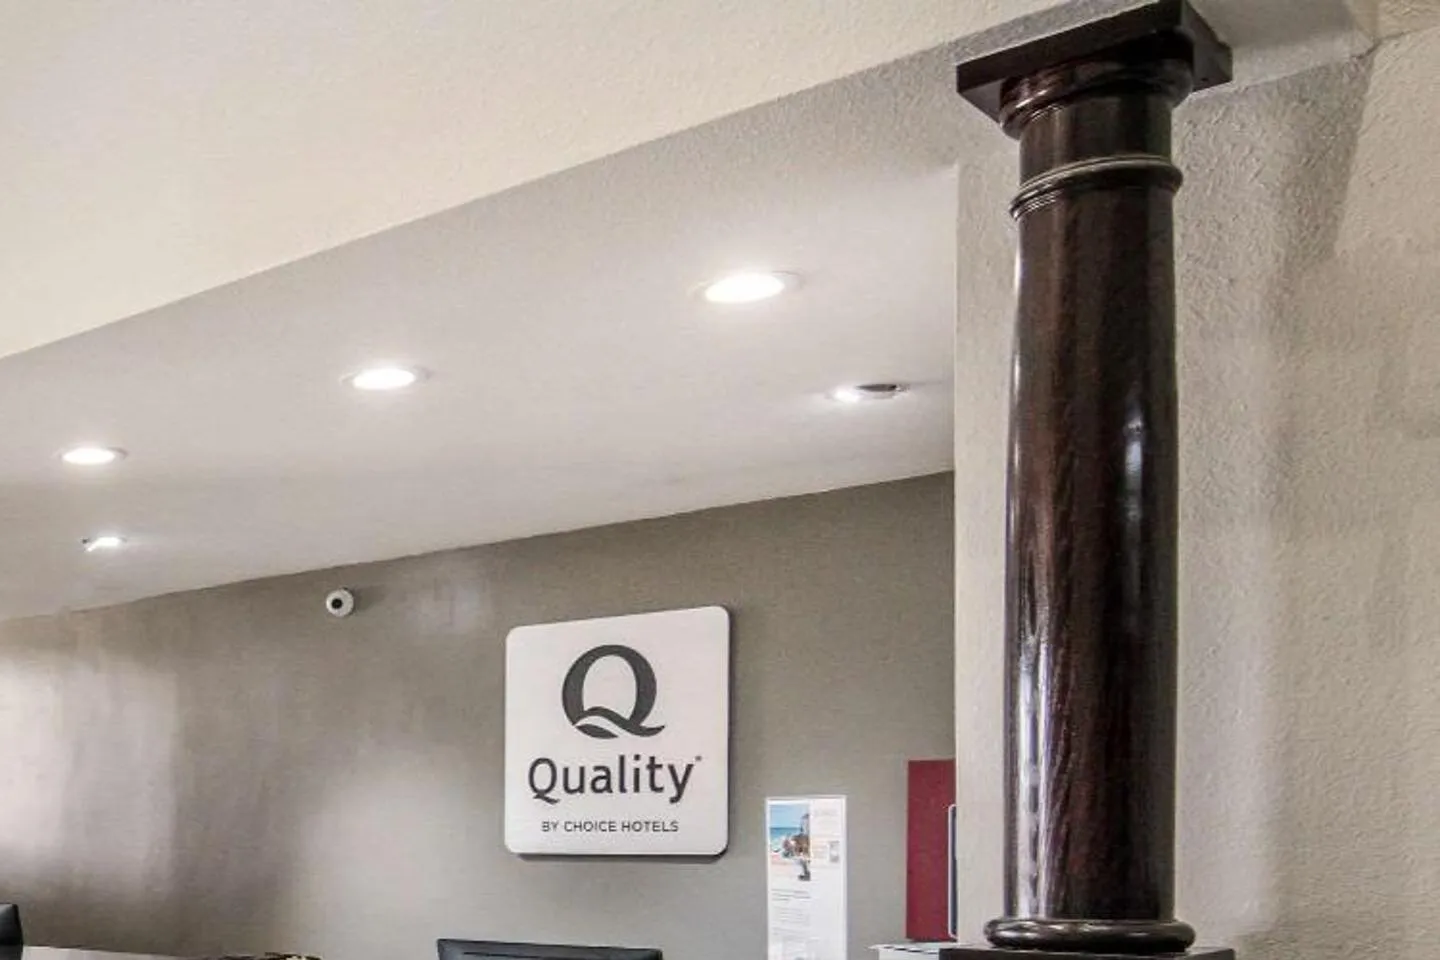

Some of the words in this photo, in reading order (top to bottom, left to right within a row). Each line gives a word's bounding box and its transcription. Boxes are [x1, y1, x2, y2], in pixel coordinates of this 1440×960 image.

[561, 644, 666, 740] Q
[528, 753, 696, 805] Quality
[541, 820, 559, 833] BY
[563, 820, 617, 833] CHOICE
[621, 820, 679, 833] HOTELS
